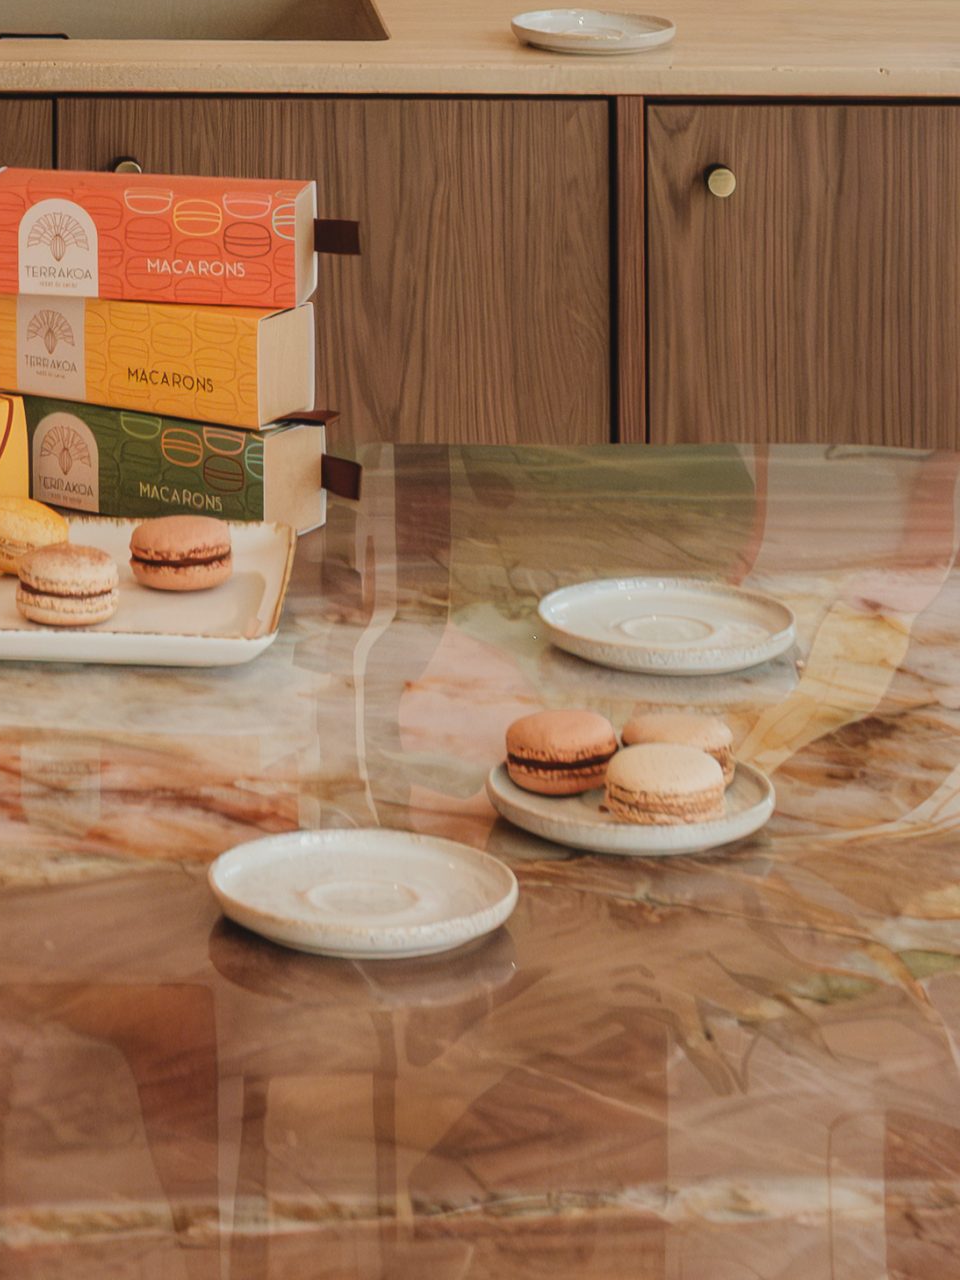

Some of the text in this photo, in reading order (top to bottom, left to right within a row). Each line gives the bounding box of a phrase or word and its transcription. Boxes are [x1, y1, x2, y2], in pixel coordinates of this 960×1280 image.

[25, 265, 93, 280] TERRAKOA
[146, 258, 246, 278] MACARONS
[24, 353, 78, 374] TERRAKOA
[127, 367, 214, 393] MACARONS
[38, 474, 94, 497] TERRAKOA
[139, 481, 223, 513] MACARONS
